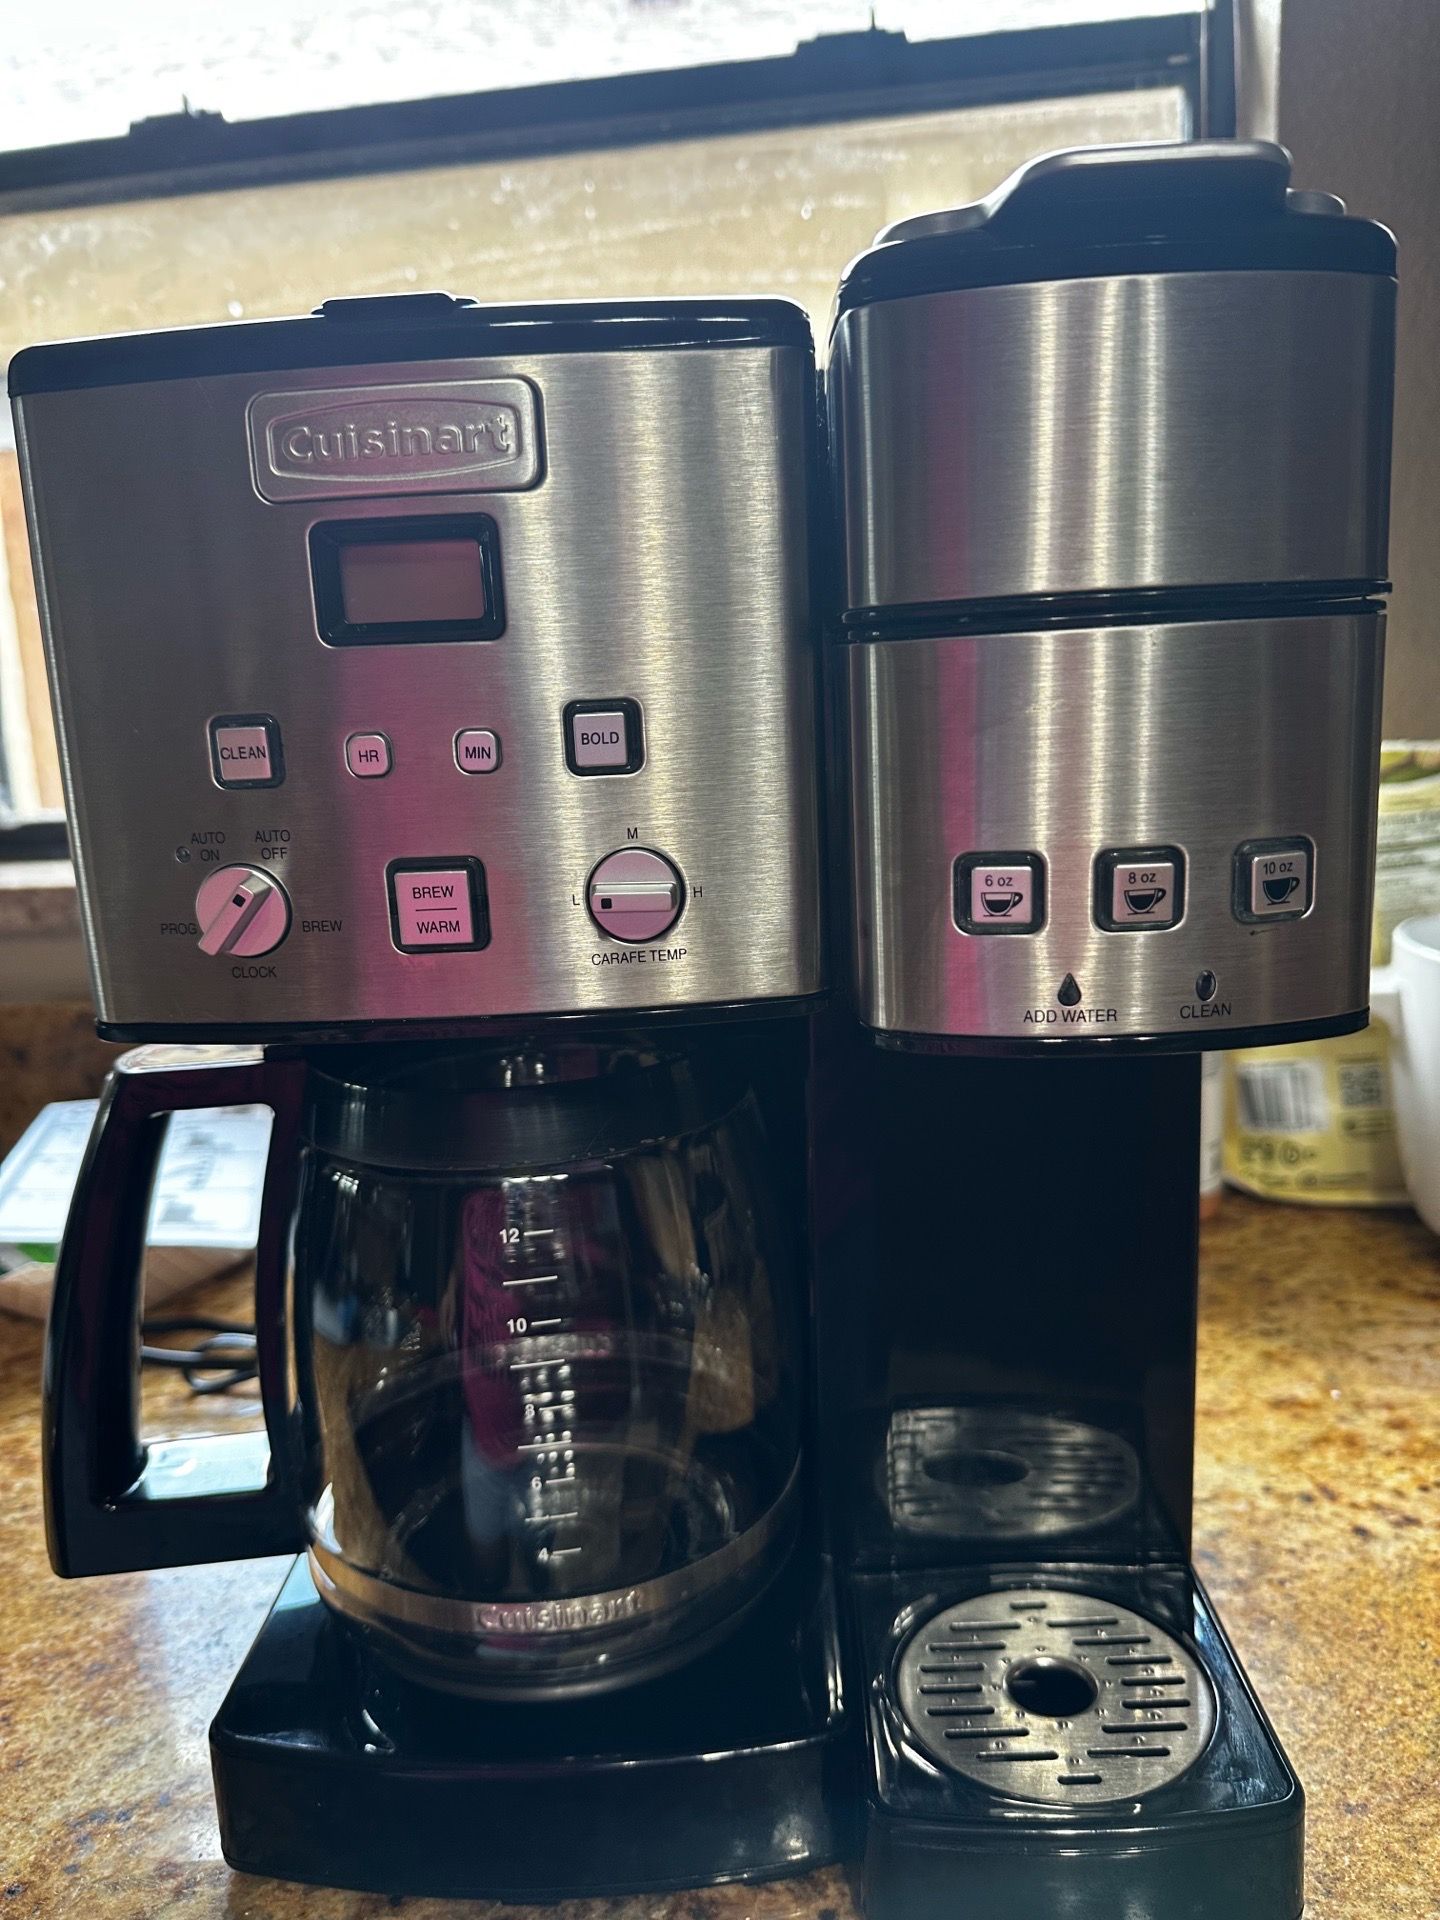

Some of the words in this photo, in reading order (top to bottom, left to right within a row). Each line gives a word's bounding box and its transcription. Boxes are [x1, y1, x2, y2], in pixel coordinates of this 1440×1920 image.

[281, 414, 511, 463] Cuisinart
[581, 731, 620, 746] BOLD
[220, 746, 267, 760] CLEAN
[358, 750, 379, 763] HR
[464, 746, 492, 760] MIN
[190, 831, 226, 845] AUTO
[255, 829, 291, 843] AUTO
[626, 827, 639, 840] M
[200, 850, 220, 861] ON
[261, 847, 288, 860] OFF
[1262, 862, 1277, 875] 10
[1279, 861, 1293, 873] oz
[984, 874, 995, 887] 6
[997, 877, 1013, 887] oz
[1127, 872, 1137, 884] 8
[1140, 873, 1156, 884] oz
[412, 885, 454, 899] BREW
[693, 886, 703, 898] H
[572, 894, 580, 906] L
[160, 923, 198, 935] PROG
[302, 920, 343, 933] BREW
[416, 920, 461, 934] WARM
[591, 950, 647, 966] CARAFE
[648, 948, 688, 962] TEMP
[231, 966, 278, 979] CLOCK
[1023, 1010, 1058, 1023] ADD
[1061, 1008, 1117, 1023] WATER
[1180, 1003, 1232, 1019] CLEAN
[500, 1227, 520, 1244] 12
[506, 1317, 527, 1334] 10
[524, 1403, 535, 1418] 8
[530, 1476, 542, 1490] 6
[537, 1547, 549, 1563] 4
[478, 1590, 641, 1629] Cuisinart
